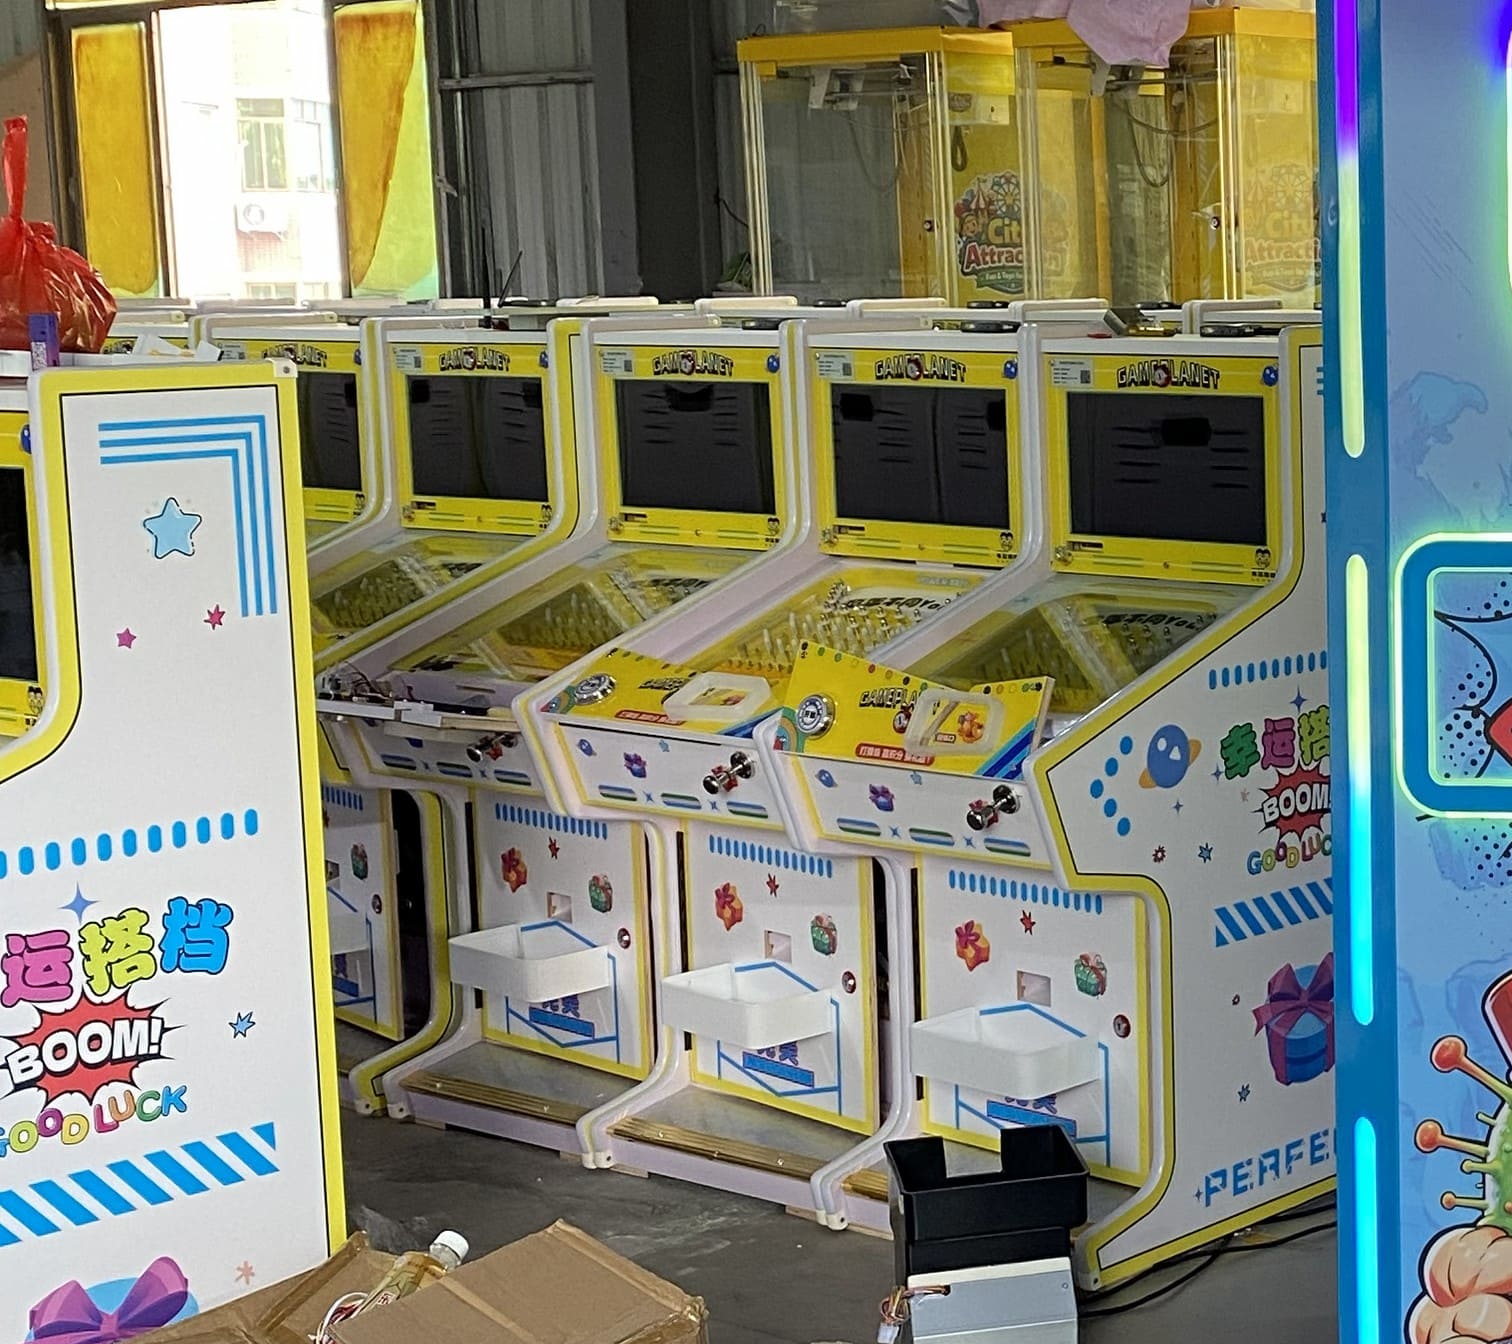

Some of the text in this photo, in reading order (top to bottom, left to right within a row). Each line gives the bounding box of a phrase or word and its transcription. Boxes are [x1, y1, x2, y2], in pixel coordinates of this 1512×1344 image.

[1262, 783, 1331, 824] BOOM
[1247, 842, 1300, 875] GOOD
[0, 897, 234, 1007] 运搭档
[6, 1017, 164, 1086] BOOM!
[94, 1086, 188, 1133] LUCK
[1205, 1128, 1336, 1207] PERFE
